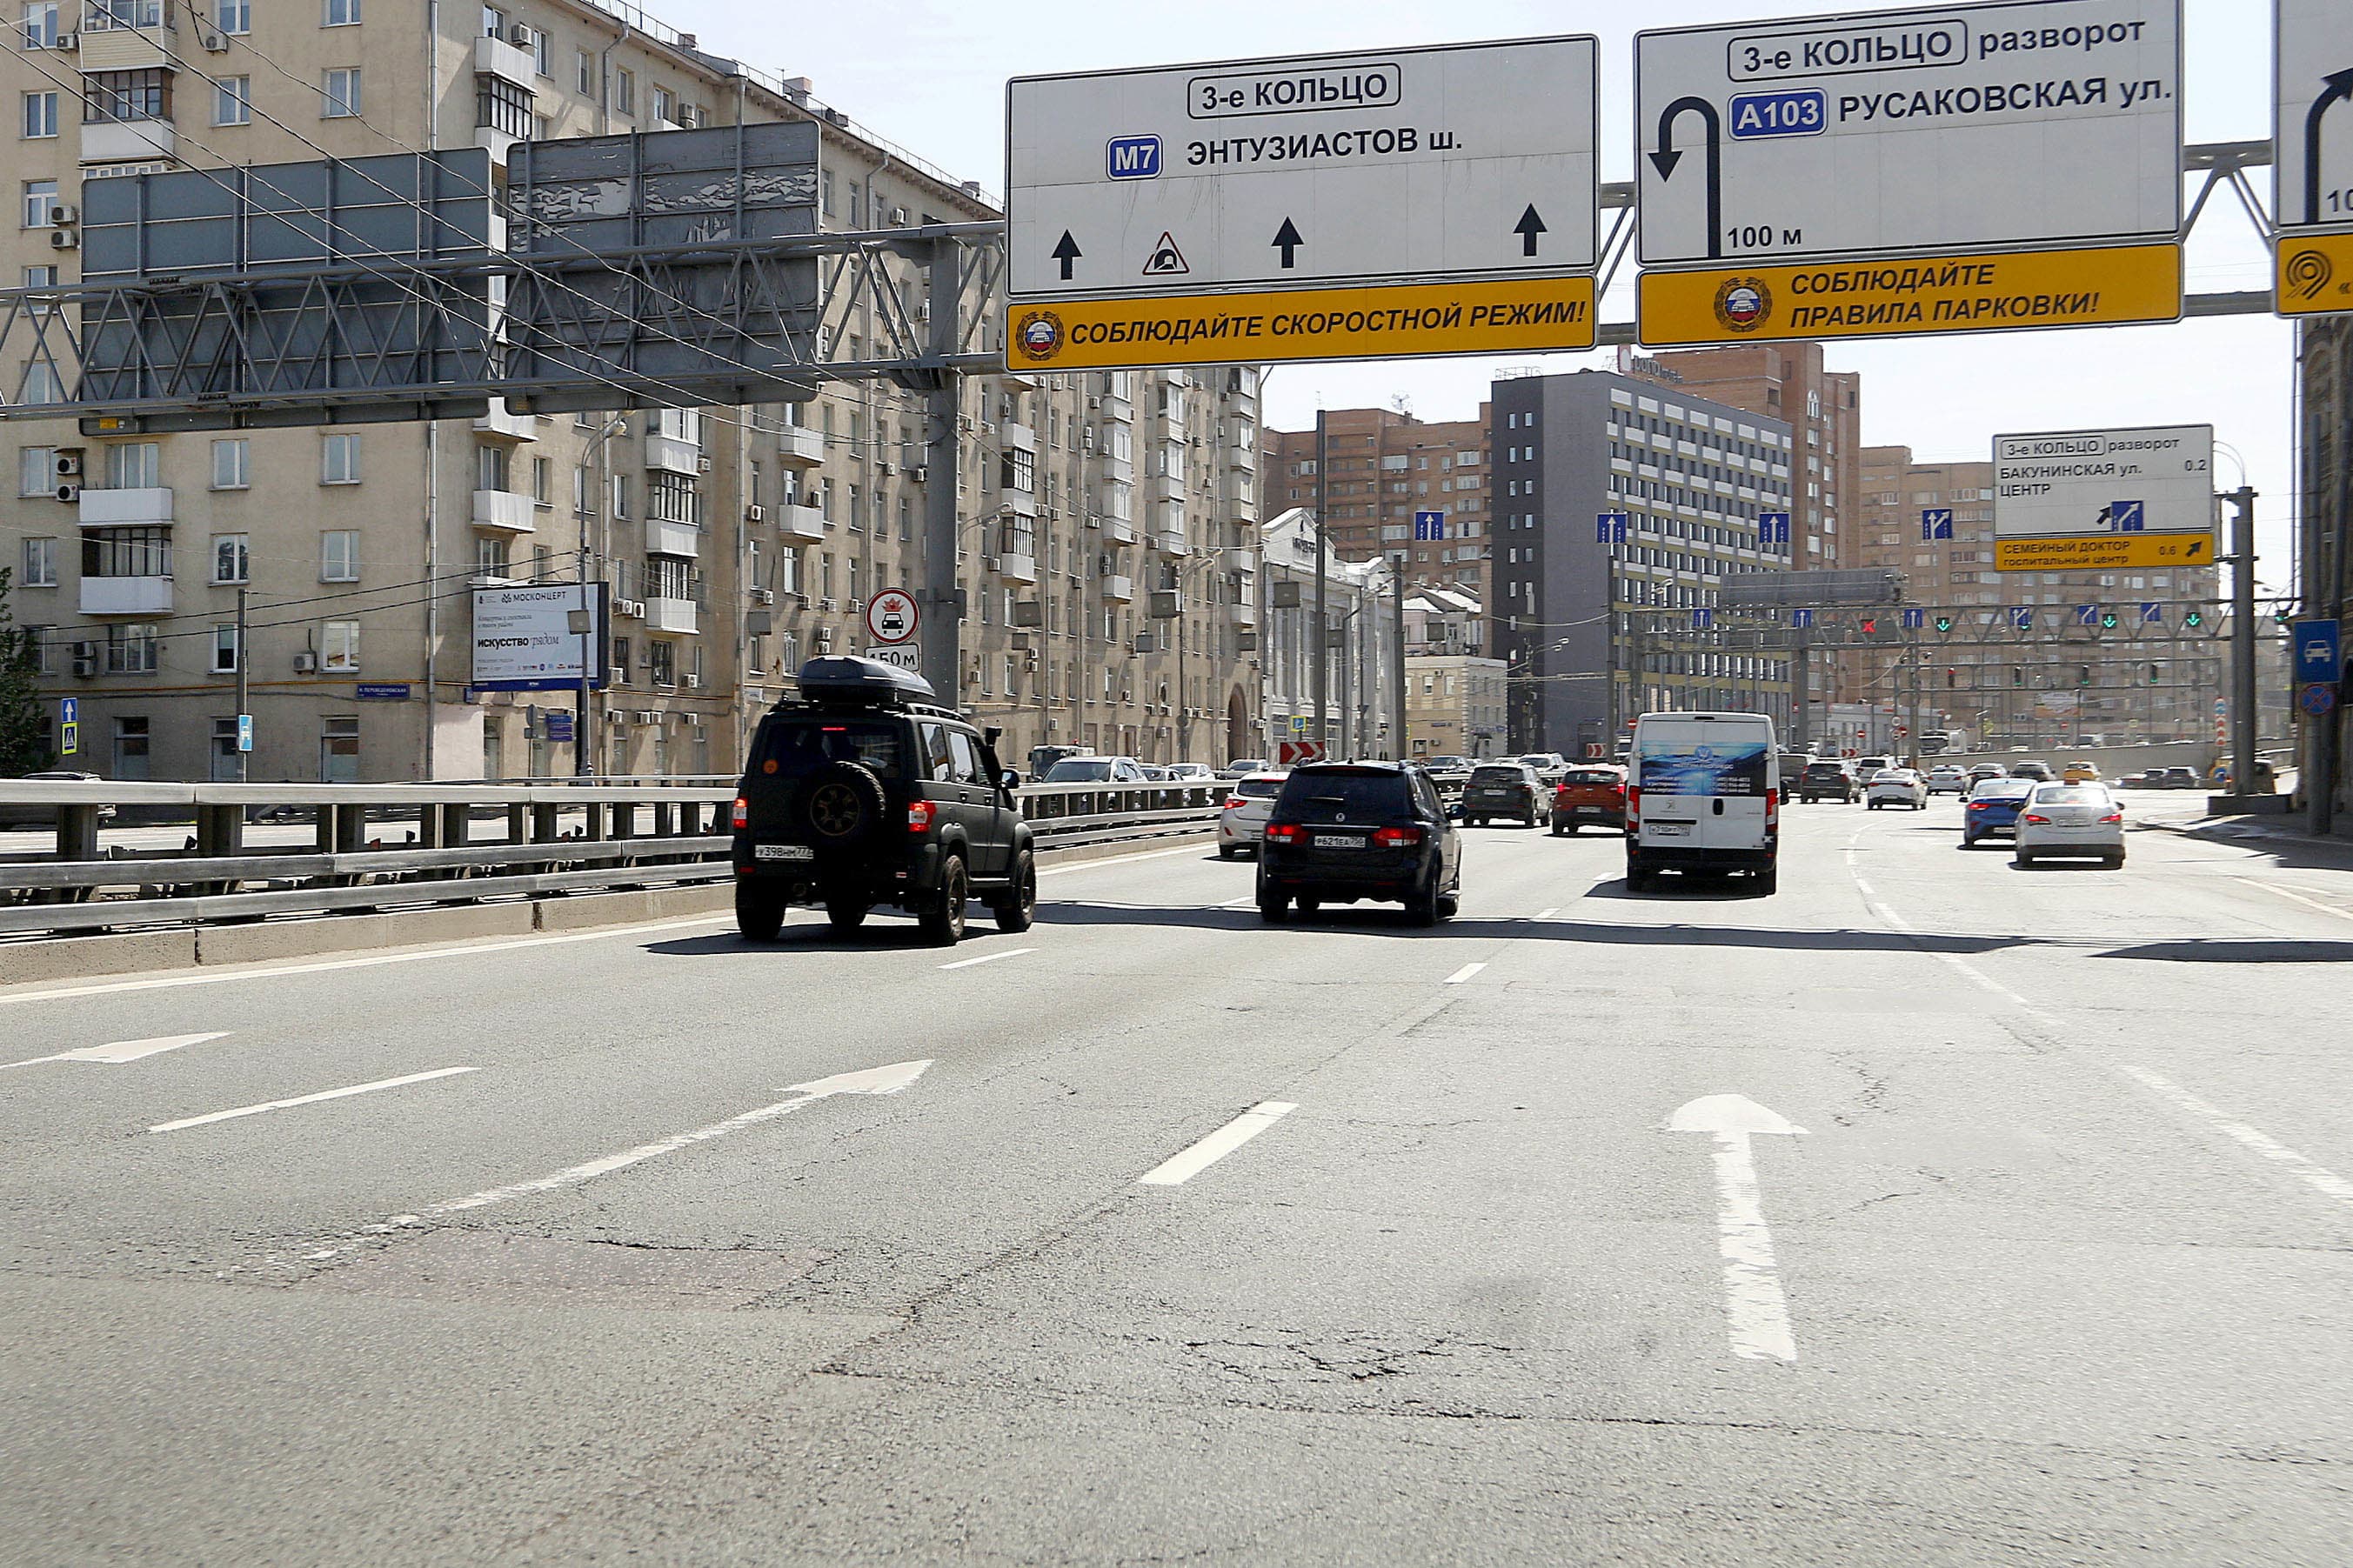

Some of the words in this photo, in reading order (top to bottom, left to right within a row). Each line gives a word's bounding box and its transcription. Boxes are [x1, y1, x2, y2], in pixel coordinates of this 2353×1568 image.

[1743, 47, 1792, 72] 3-е
[1804, 30, 1952, 68] КОЛЬЦО
[1979, 21, 2146, 60] разворот
[1202, 86, 1245, 110] 3-е
[1255, 74, 1387, 106] КОЛЬЦО
[1839, 77, 2107, 122] РУСАКОВСКАЯ
[2119, 80, 2172, 109] ул.
[1736, 98, 1821, 130] А103
[1115, 145, 1156, 170] М7
[1187, 128, 1418, 165] ЭНТУЗИАСТОВ
[1429, 132, 1462, 150] ш.
[1727, 226, 1773, 248] 100
[1783, 229, 1802, 245] м
[1791, 261, 1995, 295] СОБЛЮДАЙТЕ
[1790, 302, 1923, 330] ПРАВИЛА
[1932, 292, 2100, 322] ПАРКОВКИ!
[1071, 313, 1261, 345] СОБЛЮДАЙТЕ
[1271, 303, 1461, 336] СКОРОСТНОЙ
[1470, 301, 1586, 327] РЕЖИМ!
[2008, 444, 2029, 455] 3-е
[2034, 440, 2099, 456] КОЛЬЦО
[2109, 437, 2180, 454] разворот
[2001, 464, 2115, 479] БАКУНИНСКАЯ
[2120, 465, 2142, 477] ул.
[2184, 459, 2206, 471] 0.2
[2001, 484, 2050, 497] ЦЕНТР
[2003, 541, 2076, 554] СЕМЕЙНЫЙ
[2079, 541, 2130, 553] ДОКТОР
[2158, 546, 2176, 556] 0.6
[2003, 557, 2089, 566] госпитальный
[2093, 555, 2129, 565] центр
[513, 591, 566, 602] МОСКОНЦЕРТ
